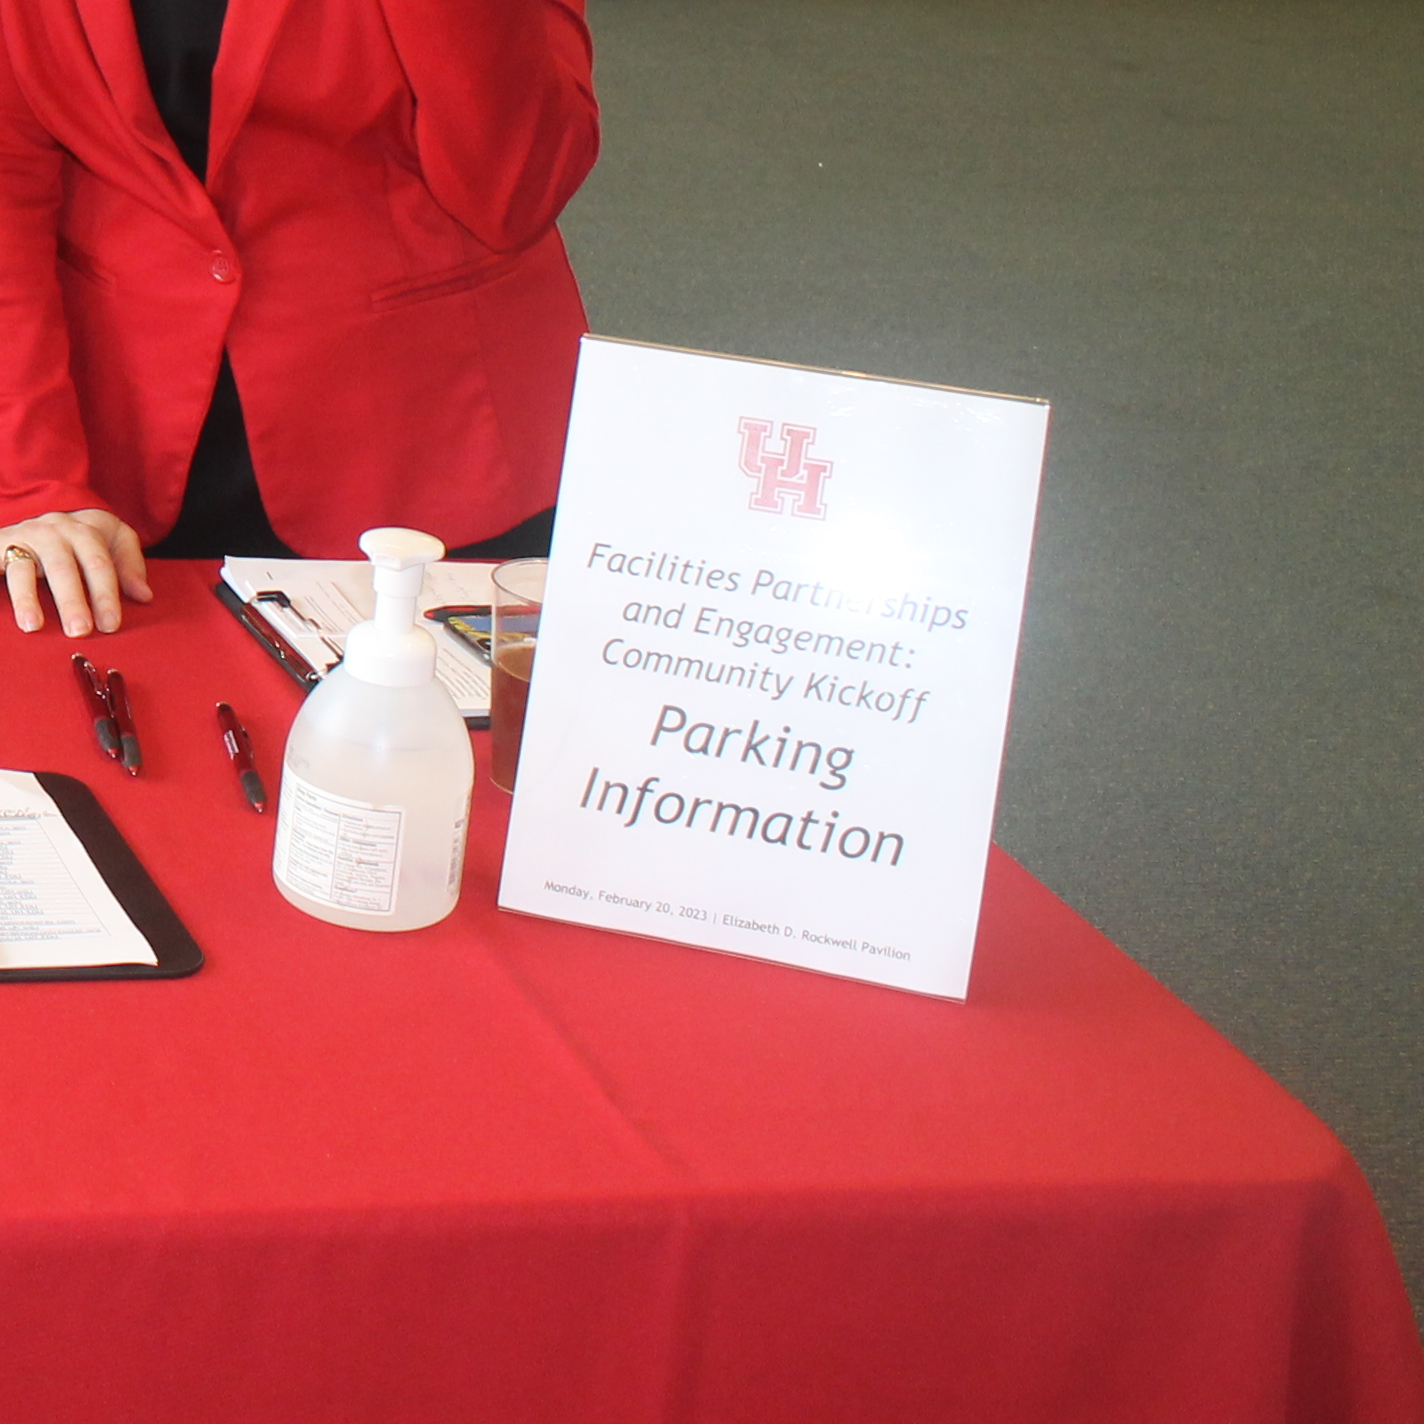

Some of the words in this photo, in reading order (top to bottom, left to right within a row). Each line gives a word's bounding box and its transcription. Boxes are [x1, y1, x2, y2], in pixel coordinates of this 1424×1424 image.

[737, 415, 834, 521] UH
[587, 542, 742, 593] Facilities
[622, 598, 683, 631] and
[693, 607, 915, 669] Engagement:
[602, 638, 793, 700] Community
[804, 674, 930, 724] Kickoff
[650, 703, 854, 791] Parking
[580, 765, 905, 867] Information
[544, 879, 593, 899] Monday,
[597, 889, 652, 912] February
[656, 899, 675, 917] 20,
[678, 906, 708, 921] 2023
[722, 912, 780, 937] Elizabeth
[784, 924, 797, 939] D.
[801, 927, 858, 952] Rockwell
[861, 939, 911, 962] Pavilion
